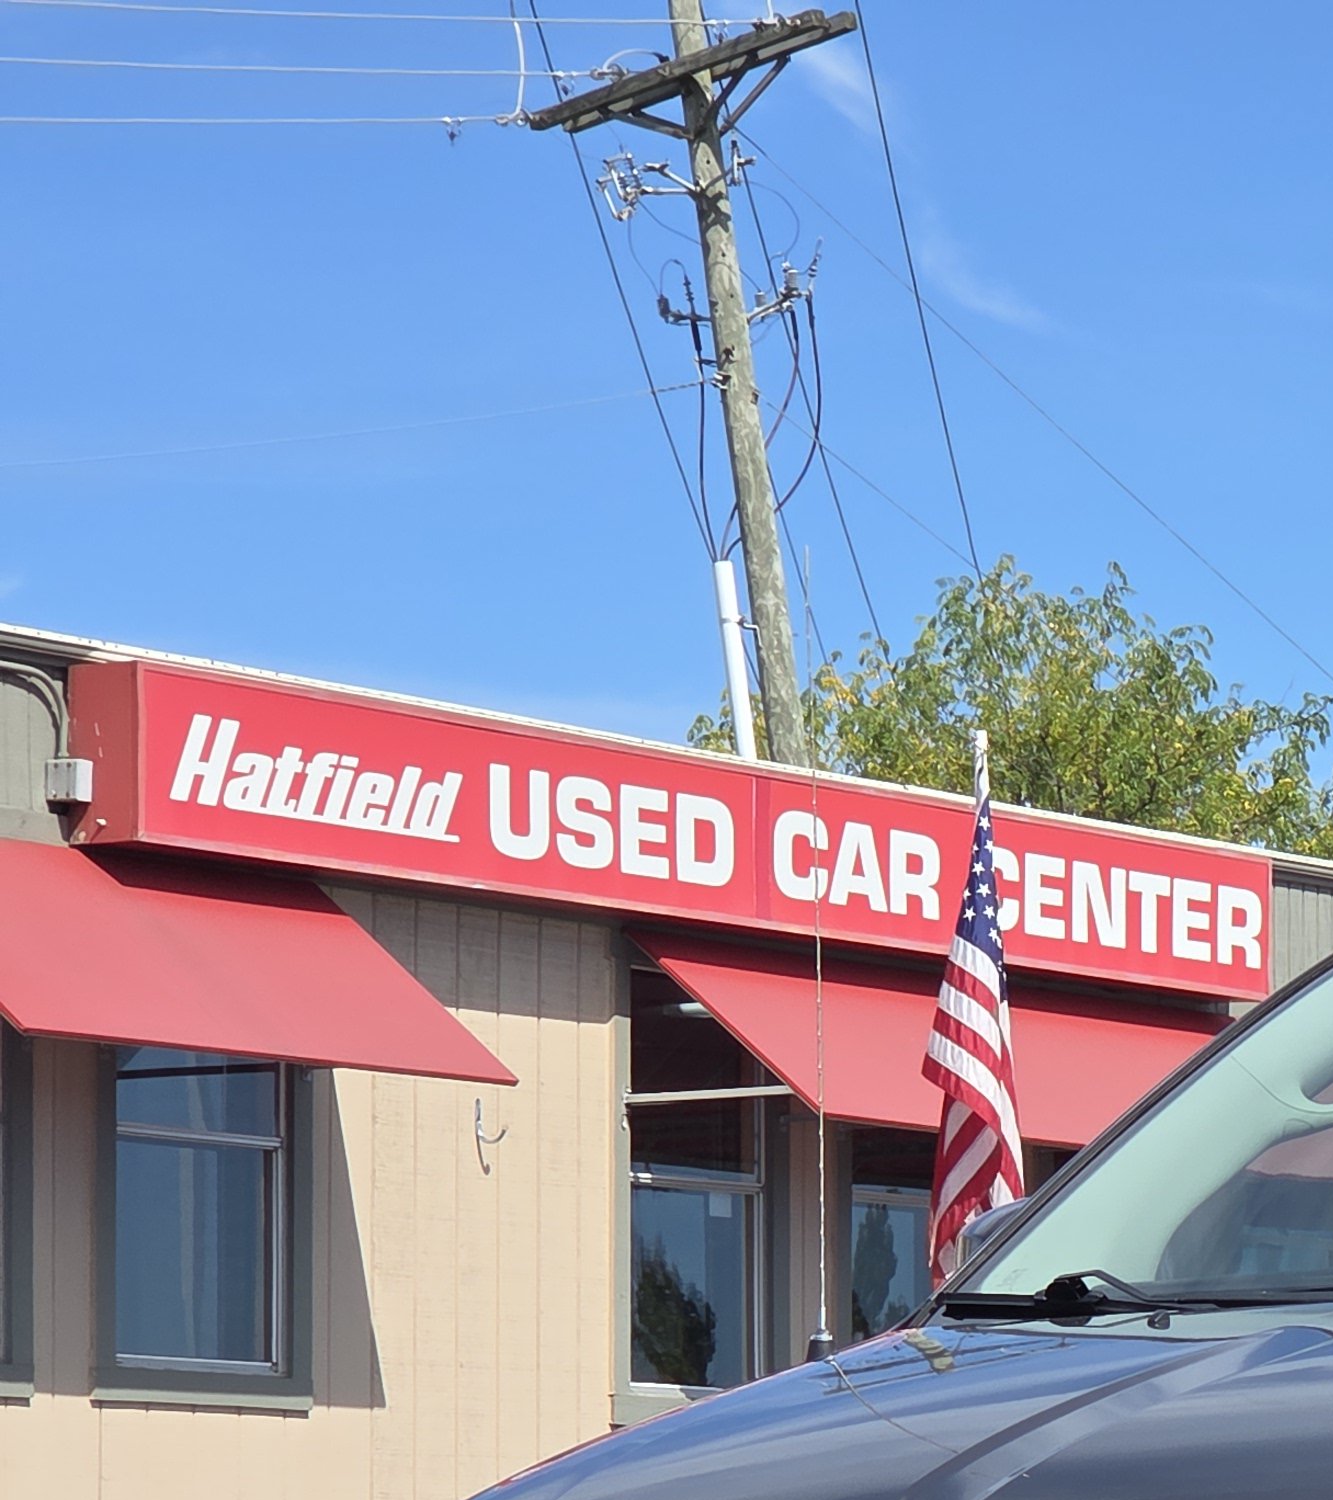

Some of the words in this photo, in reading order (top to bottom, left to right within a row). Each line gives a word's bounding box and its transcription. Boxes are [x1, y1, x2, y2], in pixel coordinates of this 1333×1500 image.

[168, 713, 463, 843] Hatfield
[488, 762, 735, 888] USED
[773, 809, 941, 921] CAR
